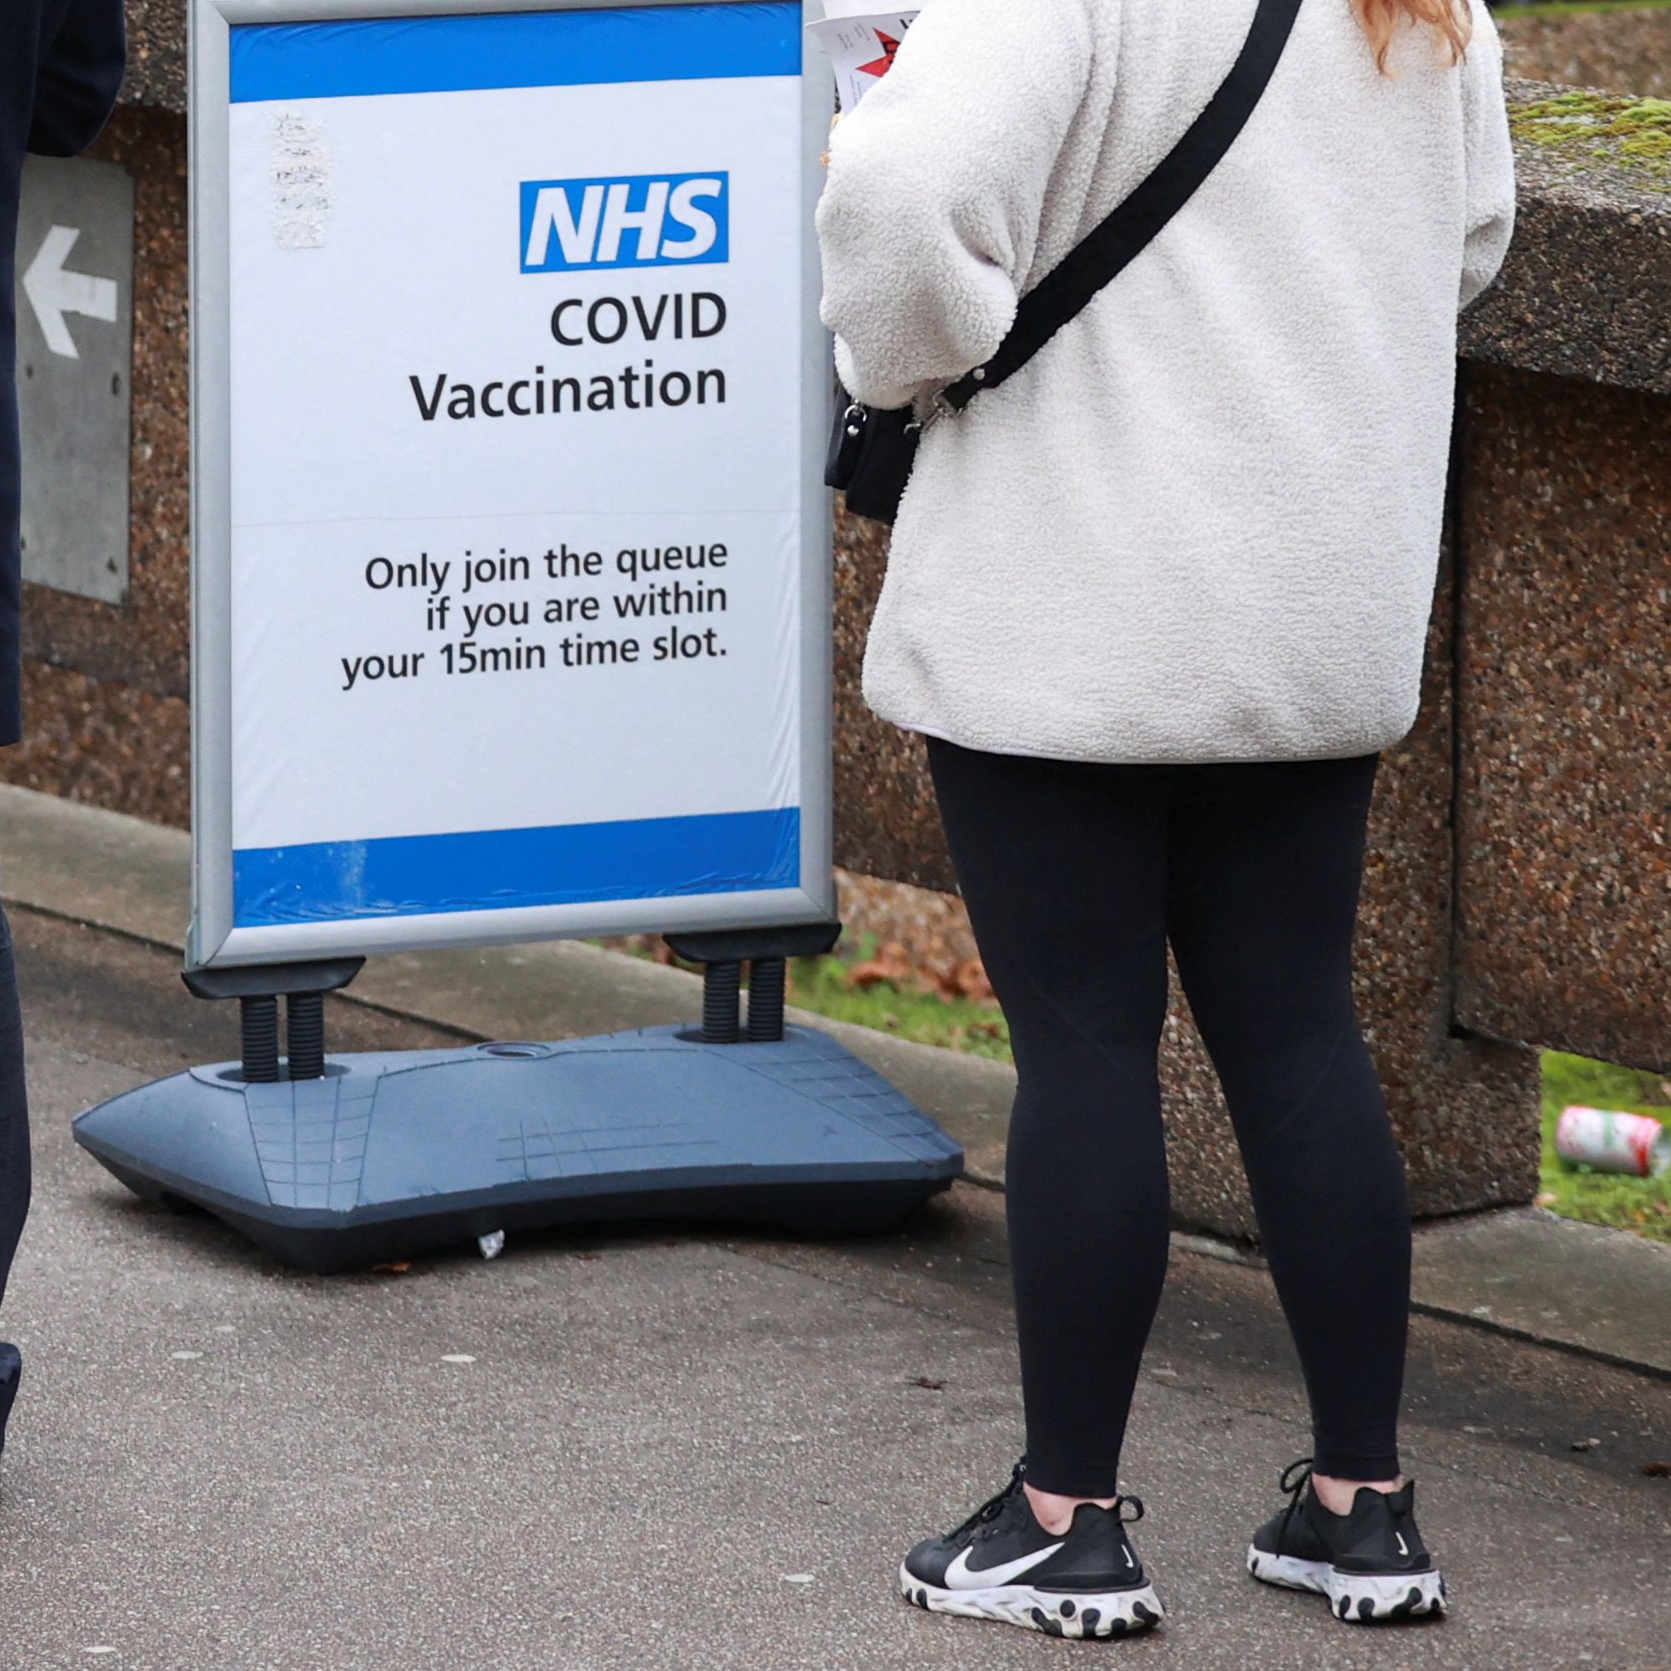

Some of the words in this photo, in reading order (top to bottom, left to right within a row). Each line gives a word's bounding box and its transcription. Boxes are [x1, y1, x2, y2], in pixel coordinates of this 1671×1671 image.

[525, 177, 722, 269] NHS
[550, 291, 727, 347] COVID
[409, 359, 726, 421] Vaccination
[365, 553, 451, 594] Only
[463, 548, 530, 593] join
[543, 543, 603, 579] the
[617, 543, 728, 580] queue
[428, 596, 451, 631] if
[462, 602, 530, 637] you
[543, 596, 600, 624] are
[614, 581, 728, 618] within
[341, 652, 425, 691] your
[440, 639, 546, 676] 15min
[559, 632, 640, 667] time
[653, 625, 727, 661] slot.
